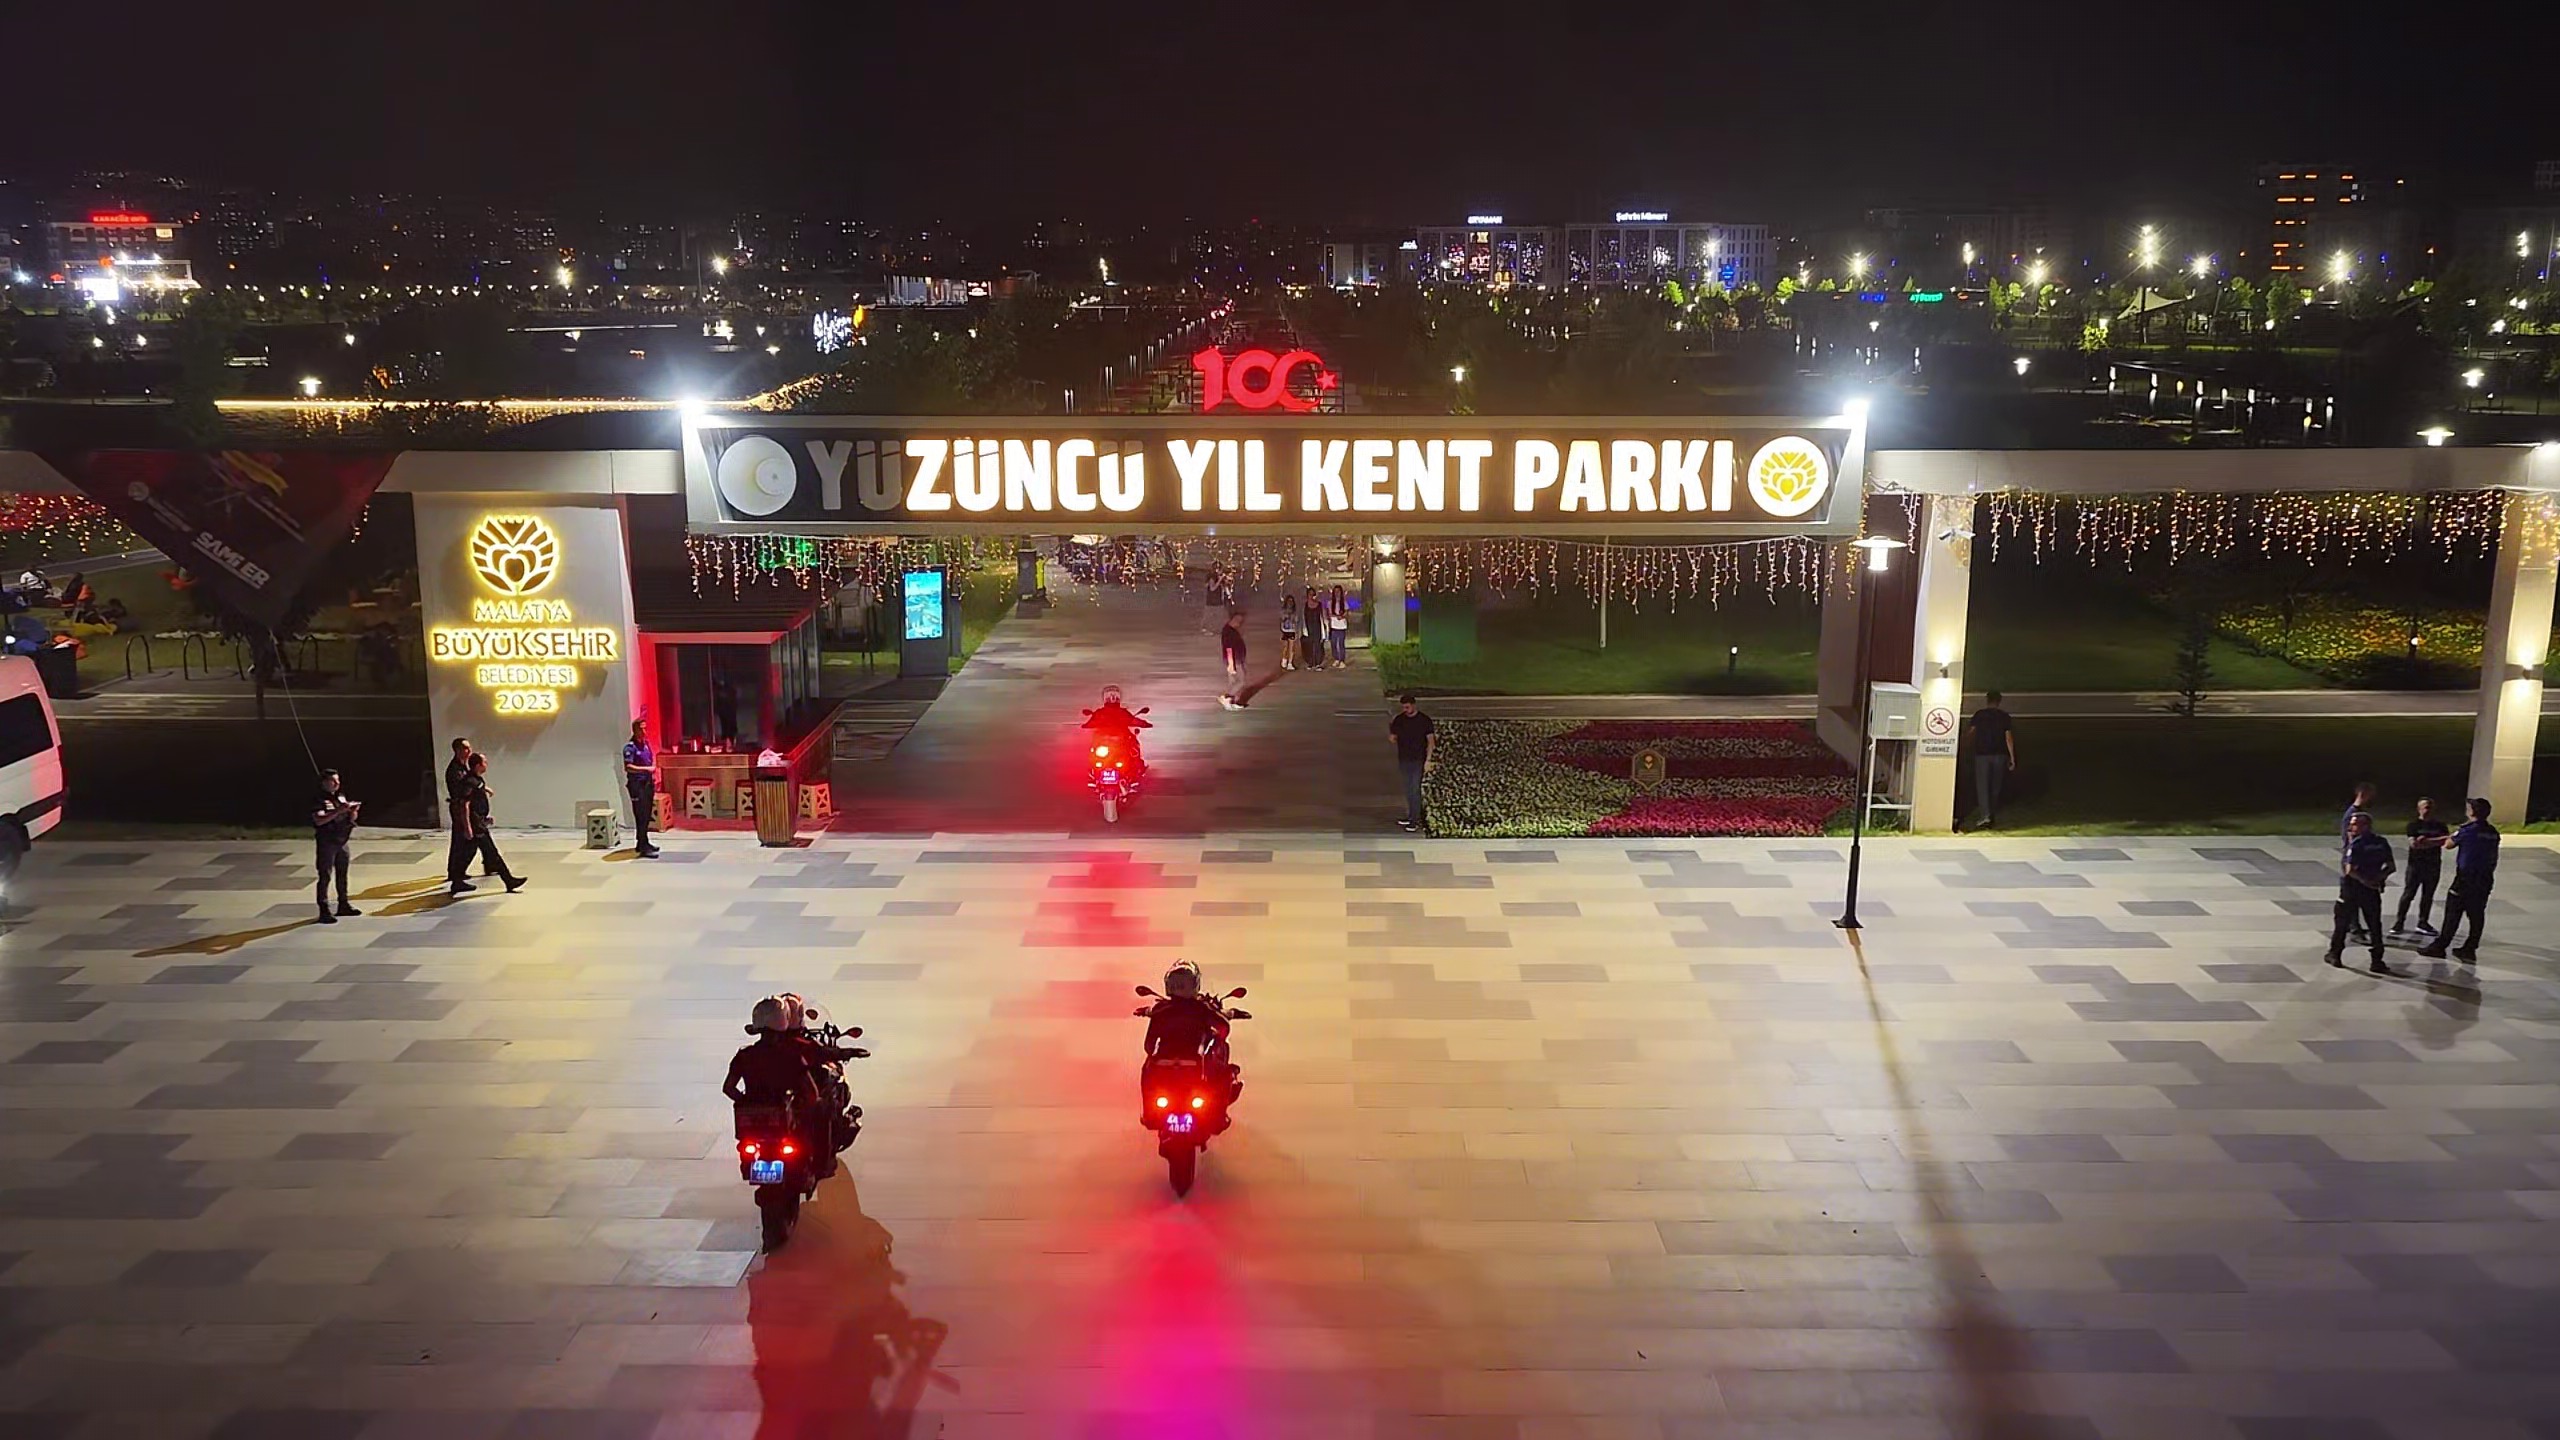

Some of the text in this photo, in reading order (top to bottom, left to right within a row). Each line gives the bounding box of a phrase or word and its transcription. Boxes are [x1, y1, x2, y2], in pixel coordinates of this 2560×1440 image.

[805, 437, 1734, 512] YÜZÜNCÜ YIL KENT PARKI
[474, 602, 569, 621] MALATYA
[497, 693, 553, 711] 2023
